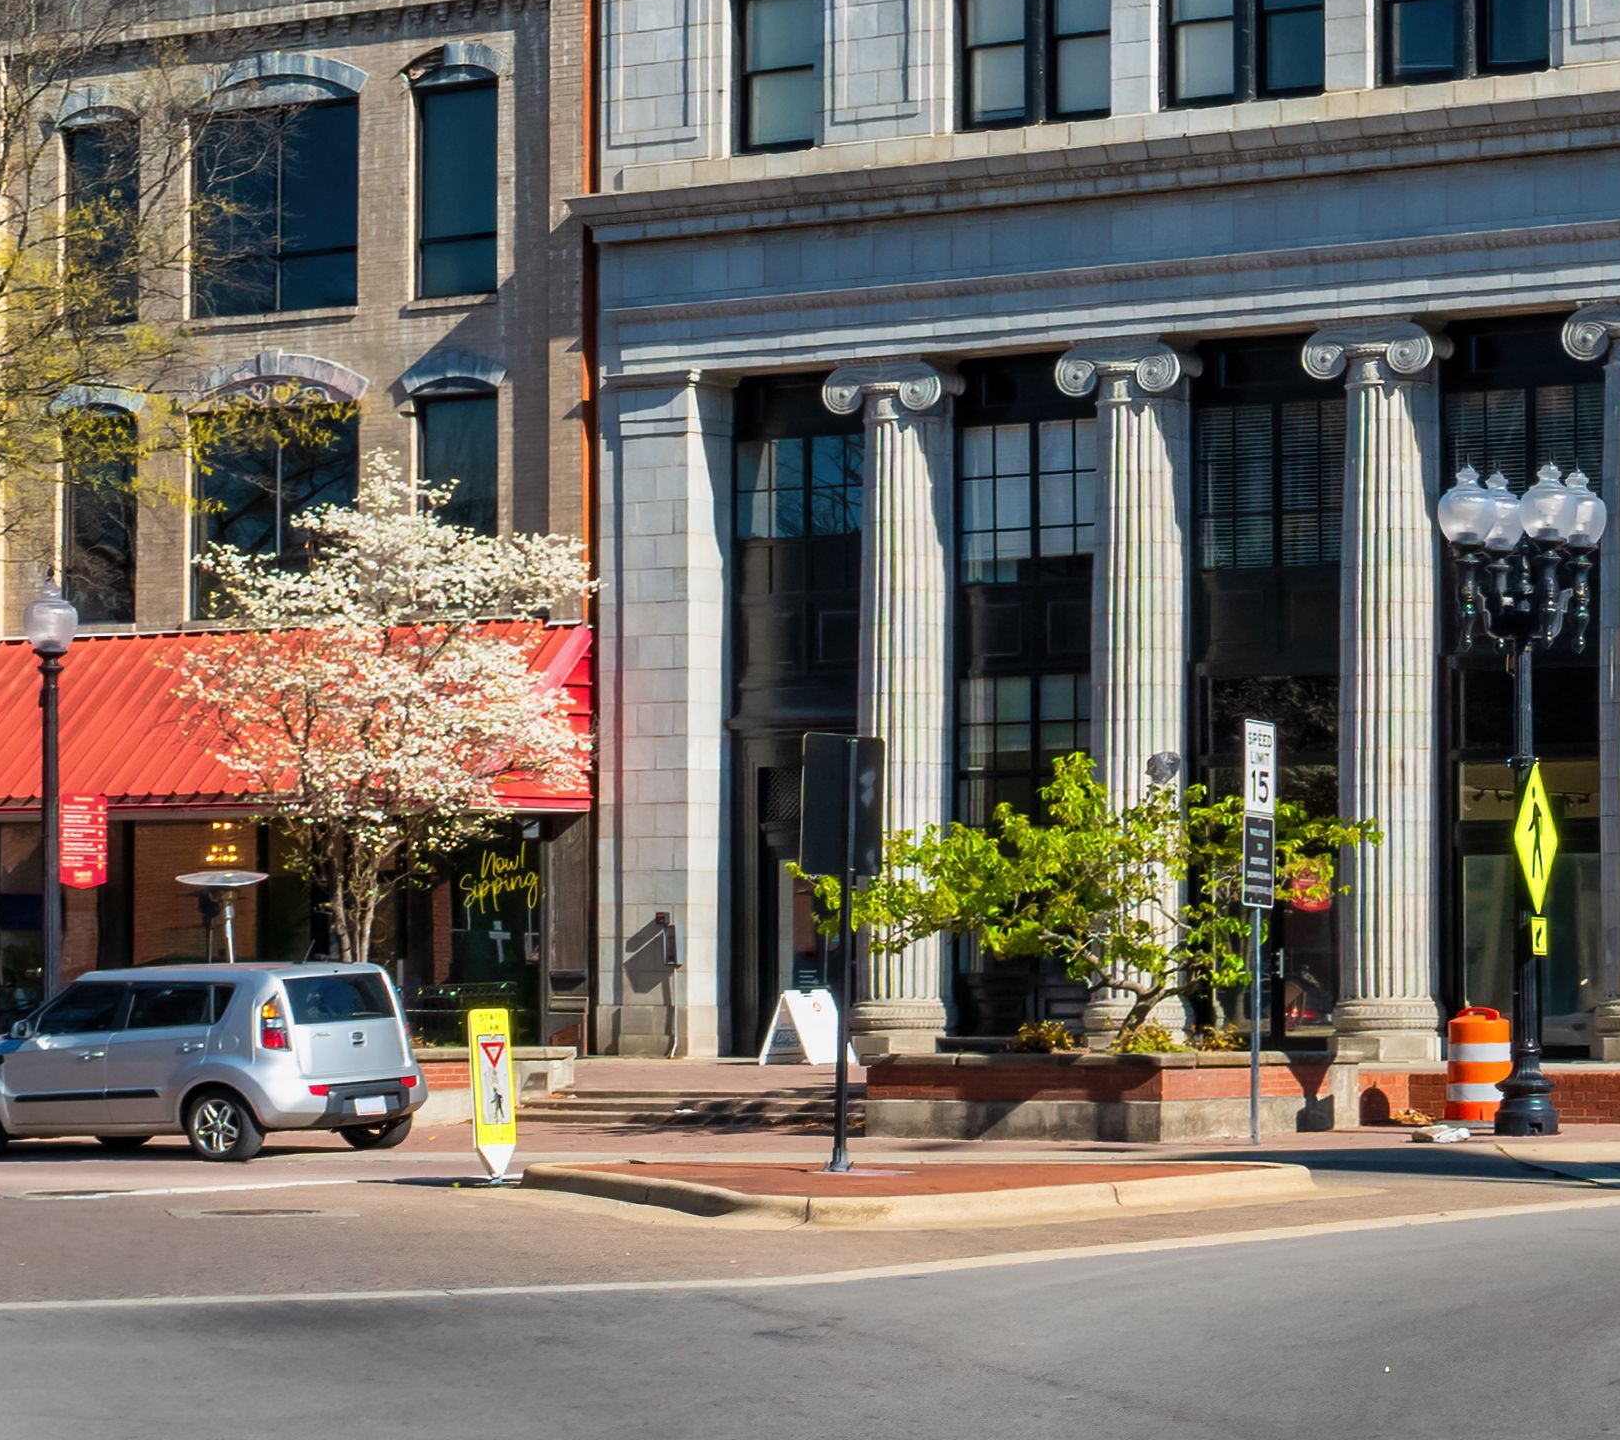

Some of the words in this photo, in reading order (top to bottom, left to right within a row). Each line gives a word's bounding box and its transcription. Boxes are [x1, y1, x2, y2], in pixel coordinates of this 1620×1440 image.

[1247, 731, 1272, 748] SPEED
[1251, 768, 1269, 804] 15
[459, 871, 540, 914] Sipping
